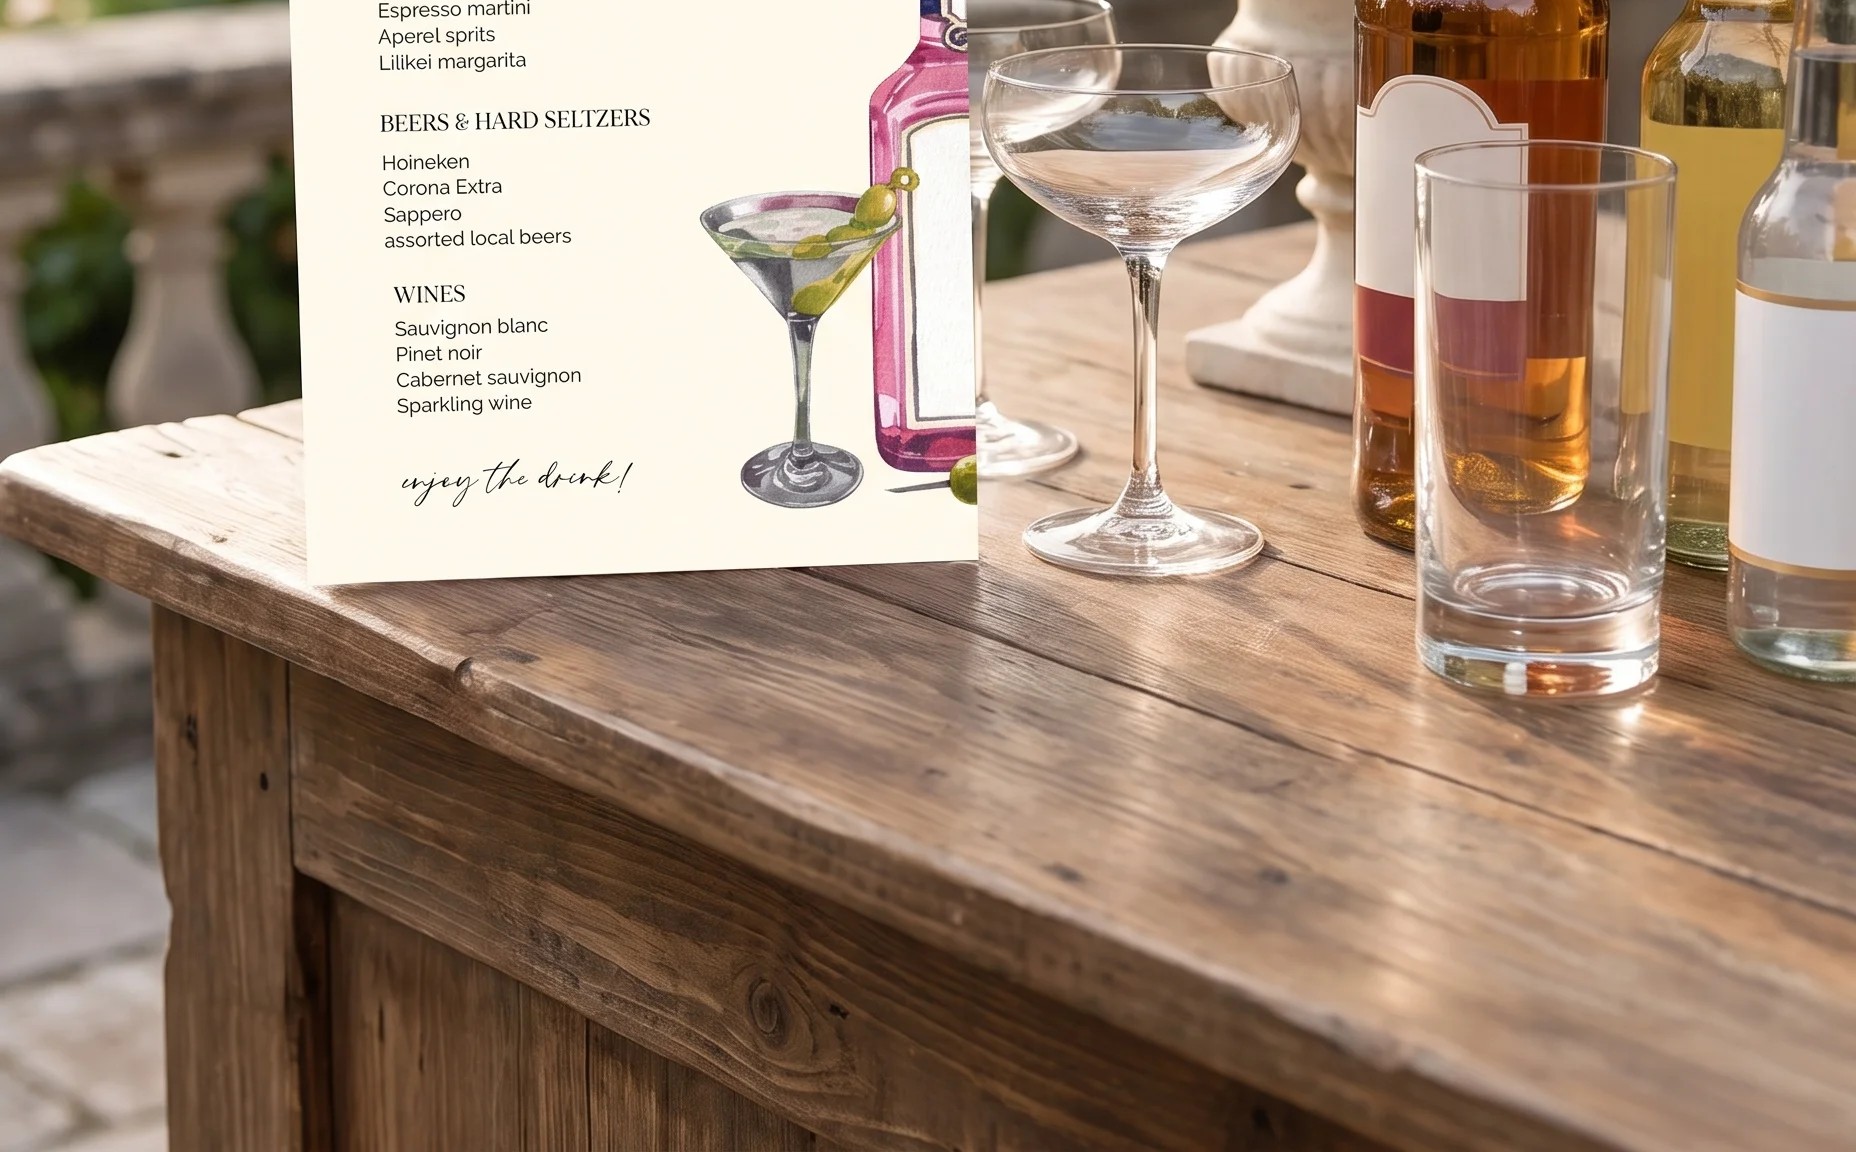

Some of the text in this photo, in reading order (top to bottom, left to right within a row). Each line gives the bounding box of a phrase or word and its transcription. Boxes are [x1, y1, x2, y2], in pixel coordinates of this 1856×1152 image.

[378, 2, 462, 23] Espresso
[377, 25, 496, 49] Aperel sprits
[379, 51, 527, 73] Lilikei margarita
[380, 107, 651, 133] BEERS & HARD SELTZERS
[382, 153, 470, 171] Hoineken
[382, 178, 503, 197] Corona Extra
[383, 206, 462, 227] Sappero
[384, 228, 572, 249] assorted local beers
[393, 284, 466, 304] WINES
[394, 317, 549, 340] Sauvignon blanc
[396, 344, 483, 363] Pinet noir
[396, 367, 582, 389] Cabernet sauvignon
[397, 394, 533, 418] Sparkling wine
[482, 458, 529, 495] the
[537, 459, 634, 494] drink!
